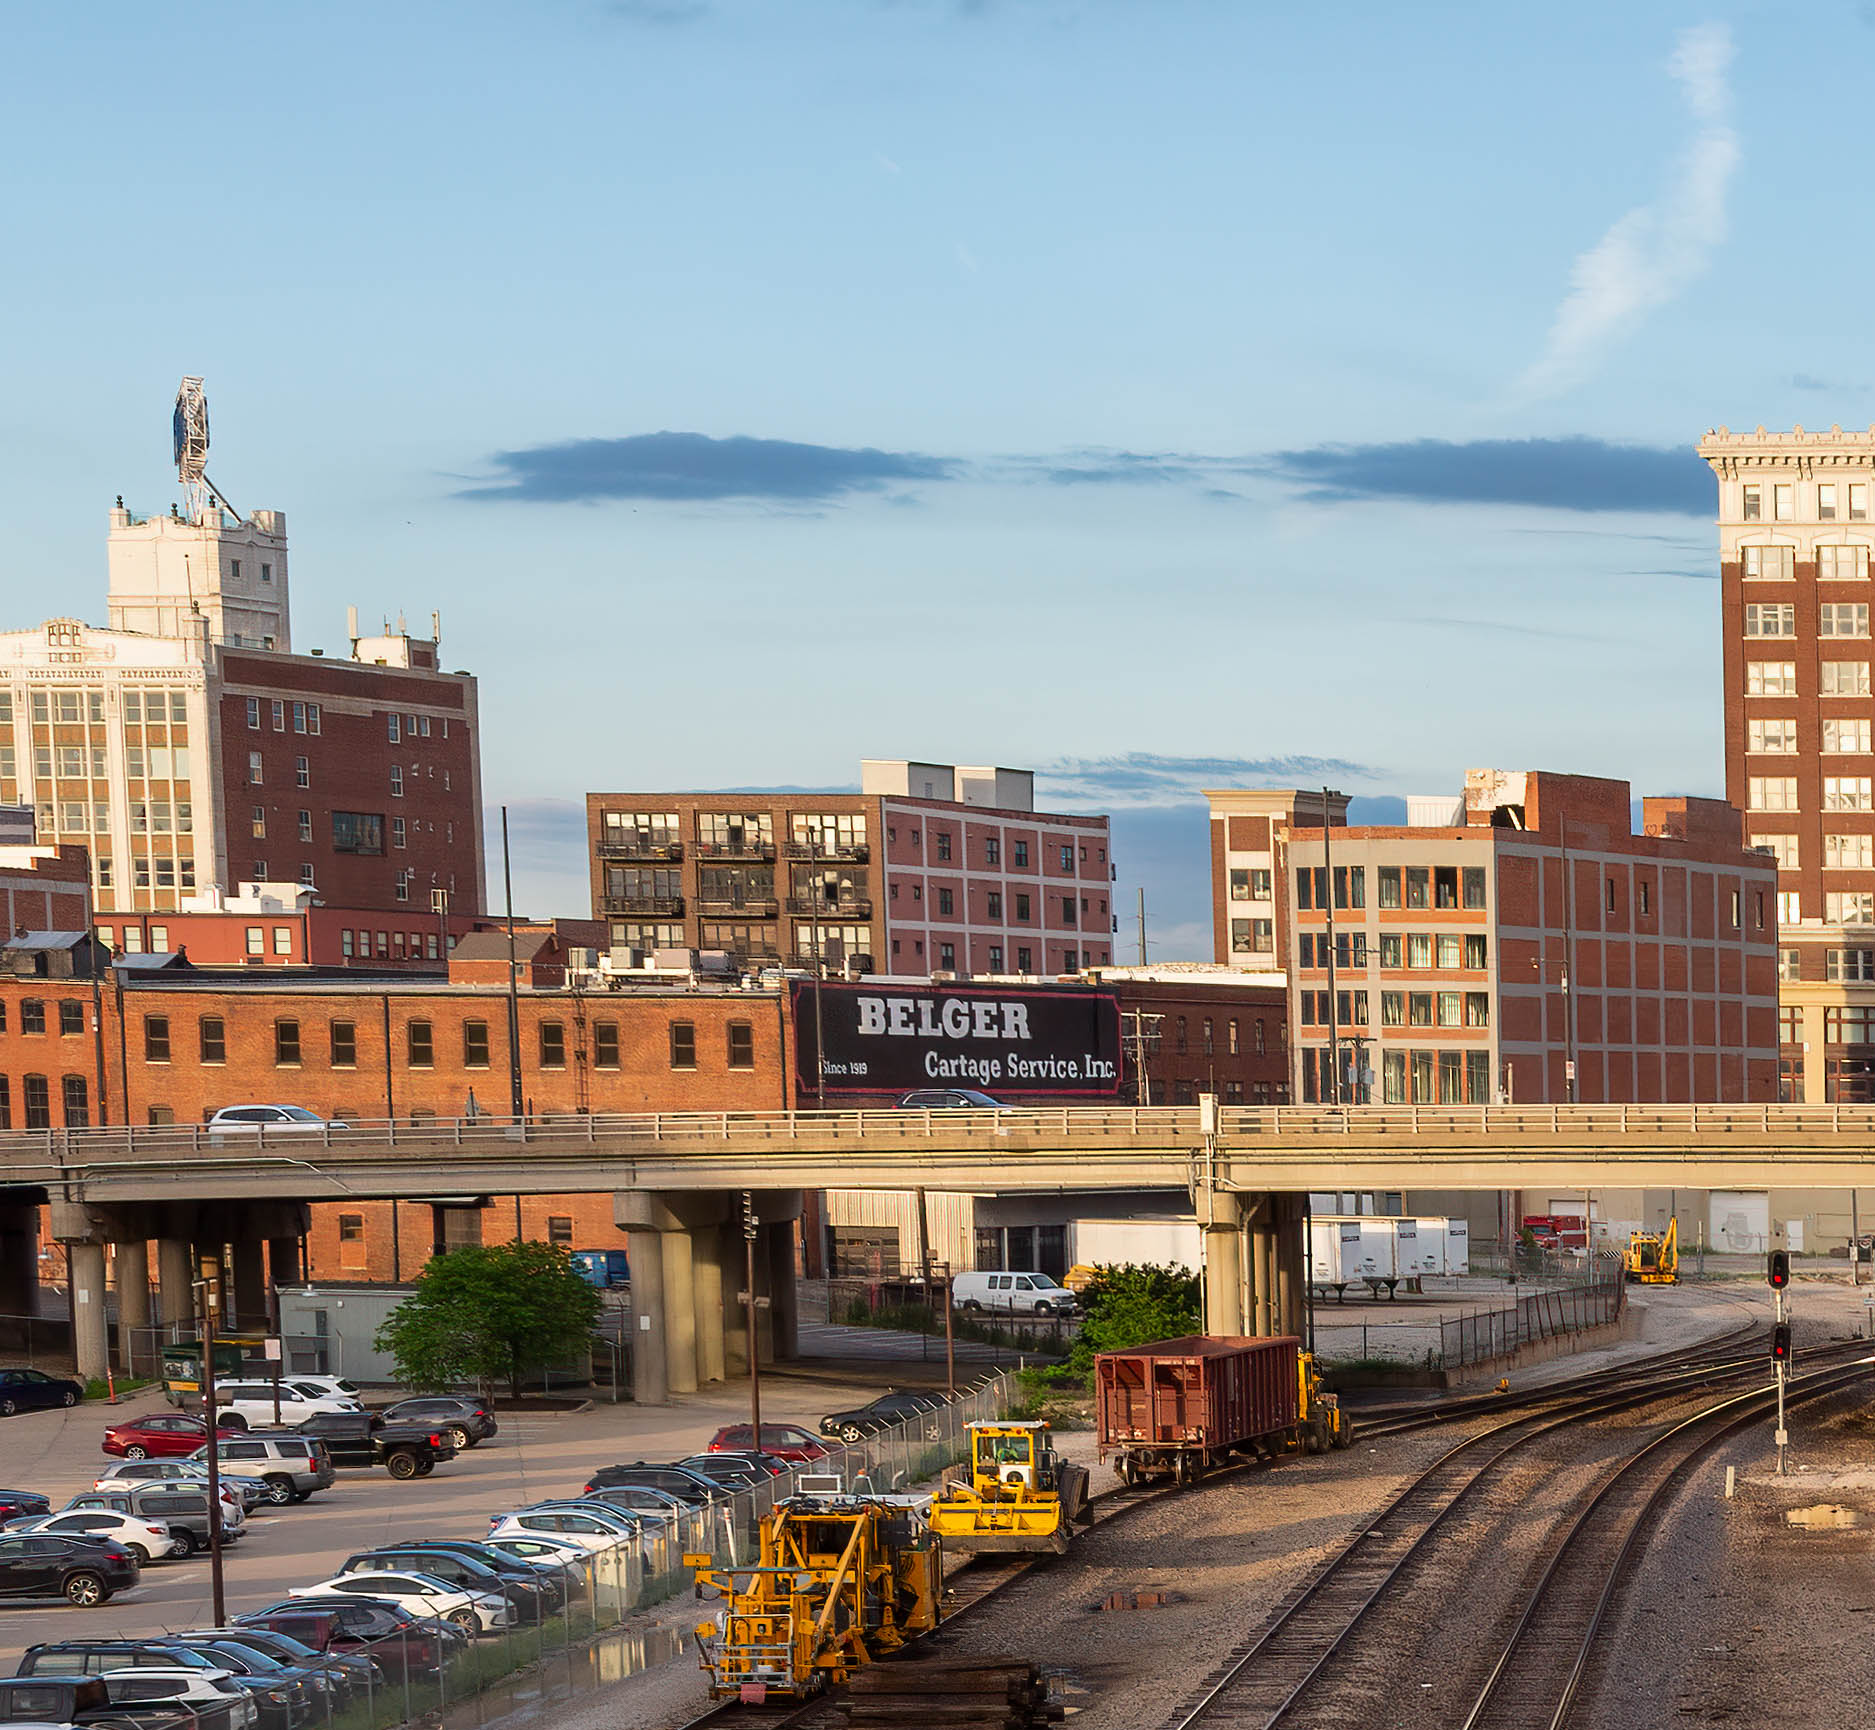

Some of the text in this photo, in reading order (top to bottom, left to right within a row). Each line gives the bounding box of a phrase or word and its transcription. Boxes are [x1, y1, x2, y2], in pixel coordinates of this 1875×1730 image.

[857, 997, 1032, 1039] BELGER
[849, 1061, 868, 1075] 1919
[925, 1050, 1001, 1085] Cartage
[1085, 1053, 1117, 1079] Inc.
